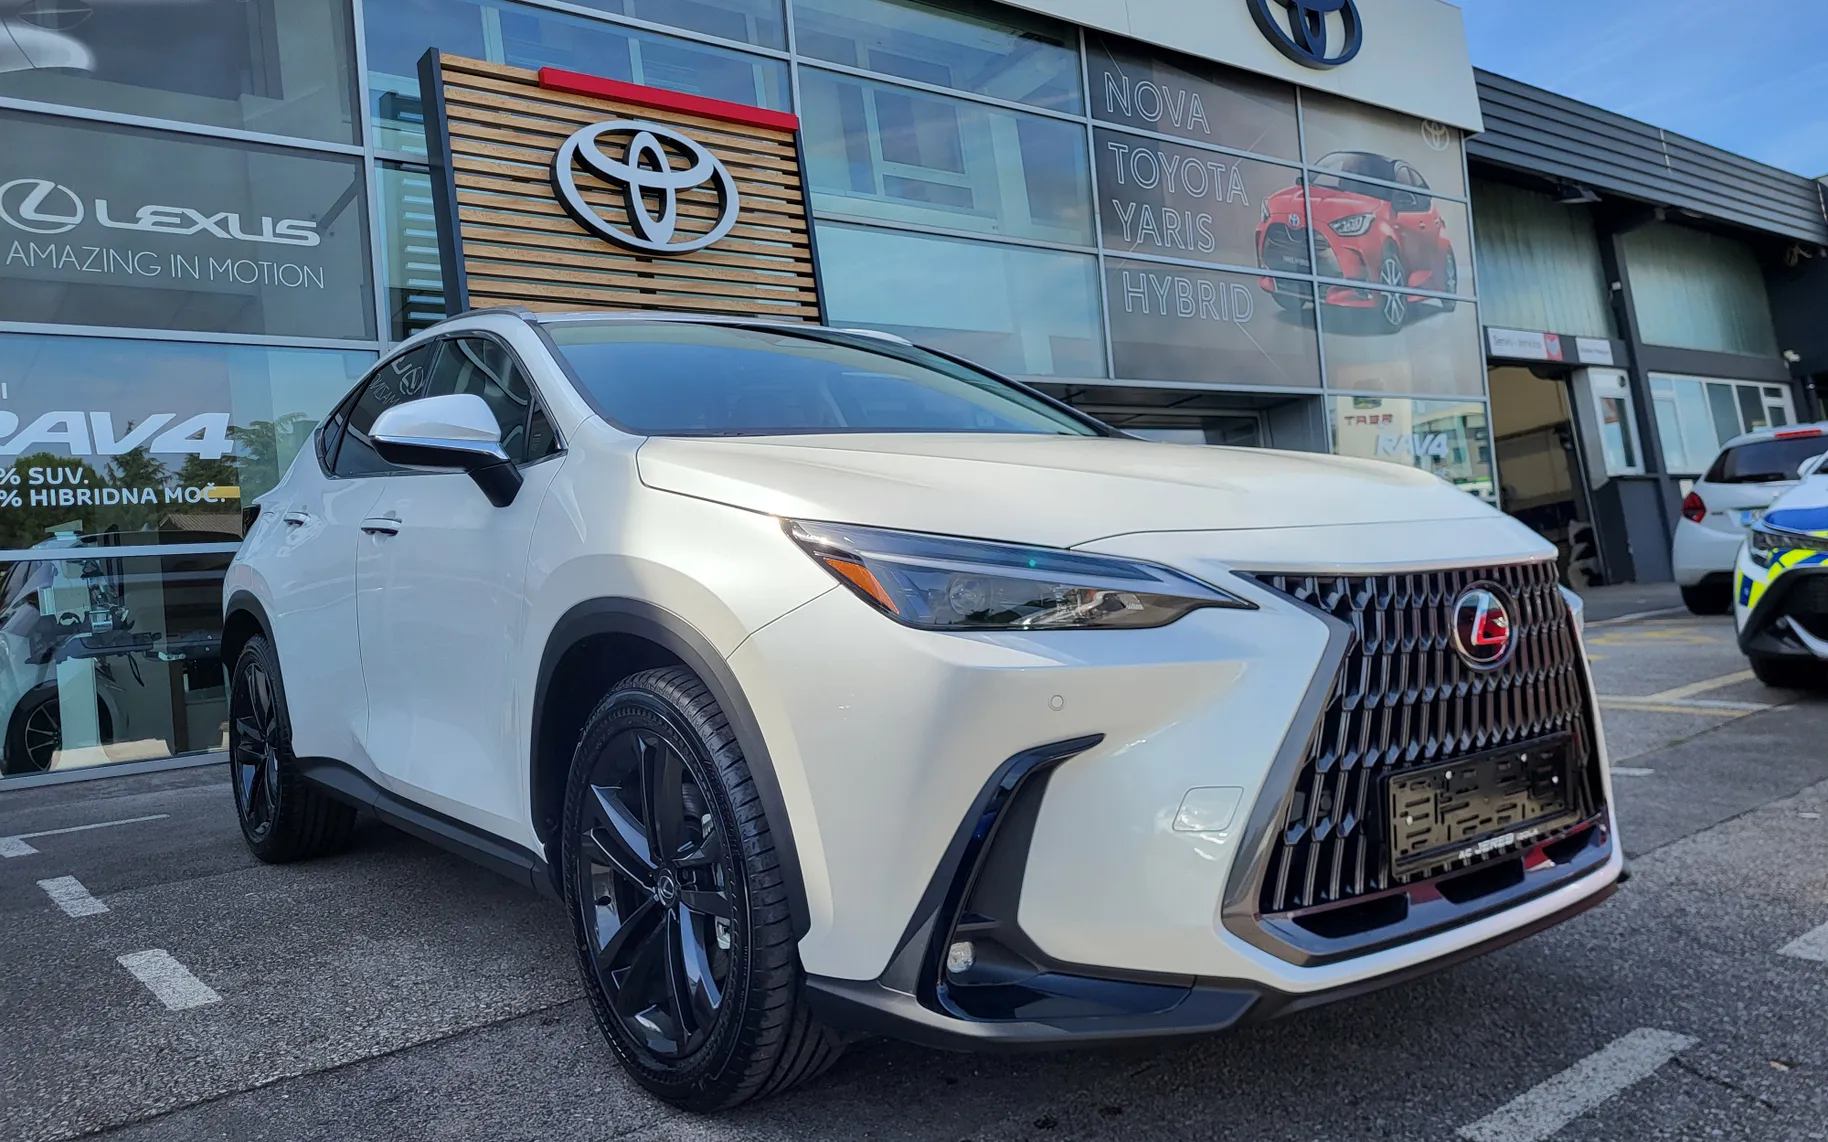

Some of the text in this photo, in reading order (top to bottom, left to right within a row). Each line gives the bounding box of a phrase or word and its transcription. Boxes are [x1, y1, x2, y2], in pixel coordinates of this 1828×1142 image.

[1104, 72, 1210, 134] NOVA
[1108, 141, 1249, 206] TOYOTA
[95, 198, 322, 247] LEXUS
[1112, 199, 1216, 253] YARIS
[6, 240, 325, 289] AMAZING IN MOTION
[1122, 271, 1253, 323] HYBRID
[1375, 433, 1449, 459] RAV4
[28, 467, 89, 485] SUV.
[30, 487, 158, 507] HIBRIDNA
[164, 482, 226, 505] MOČ.
